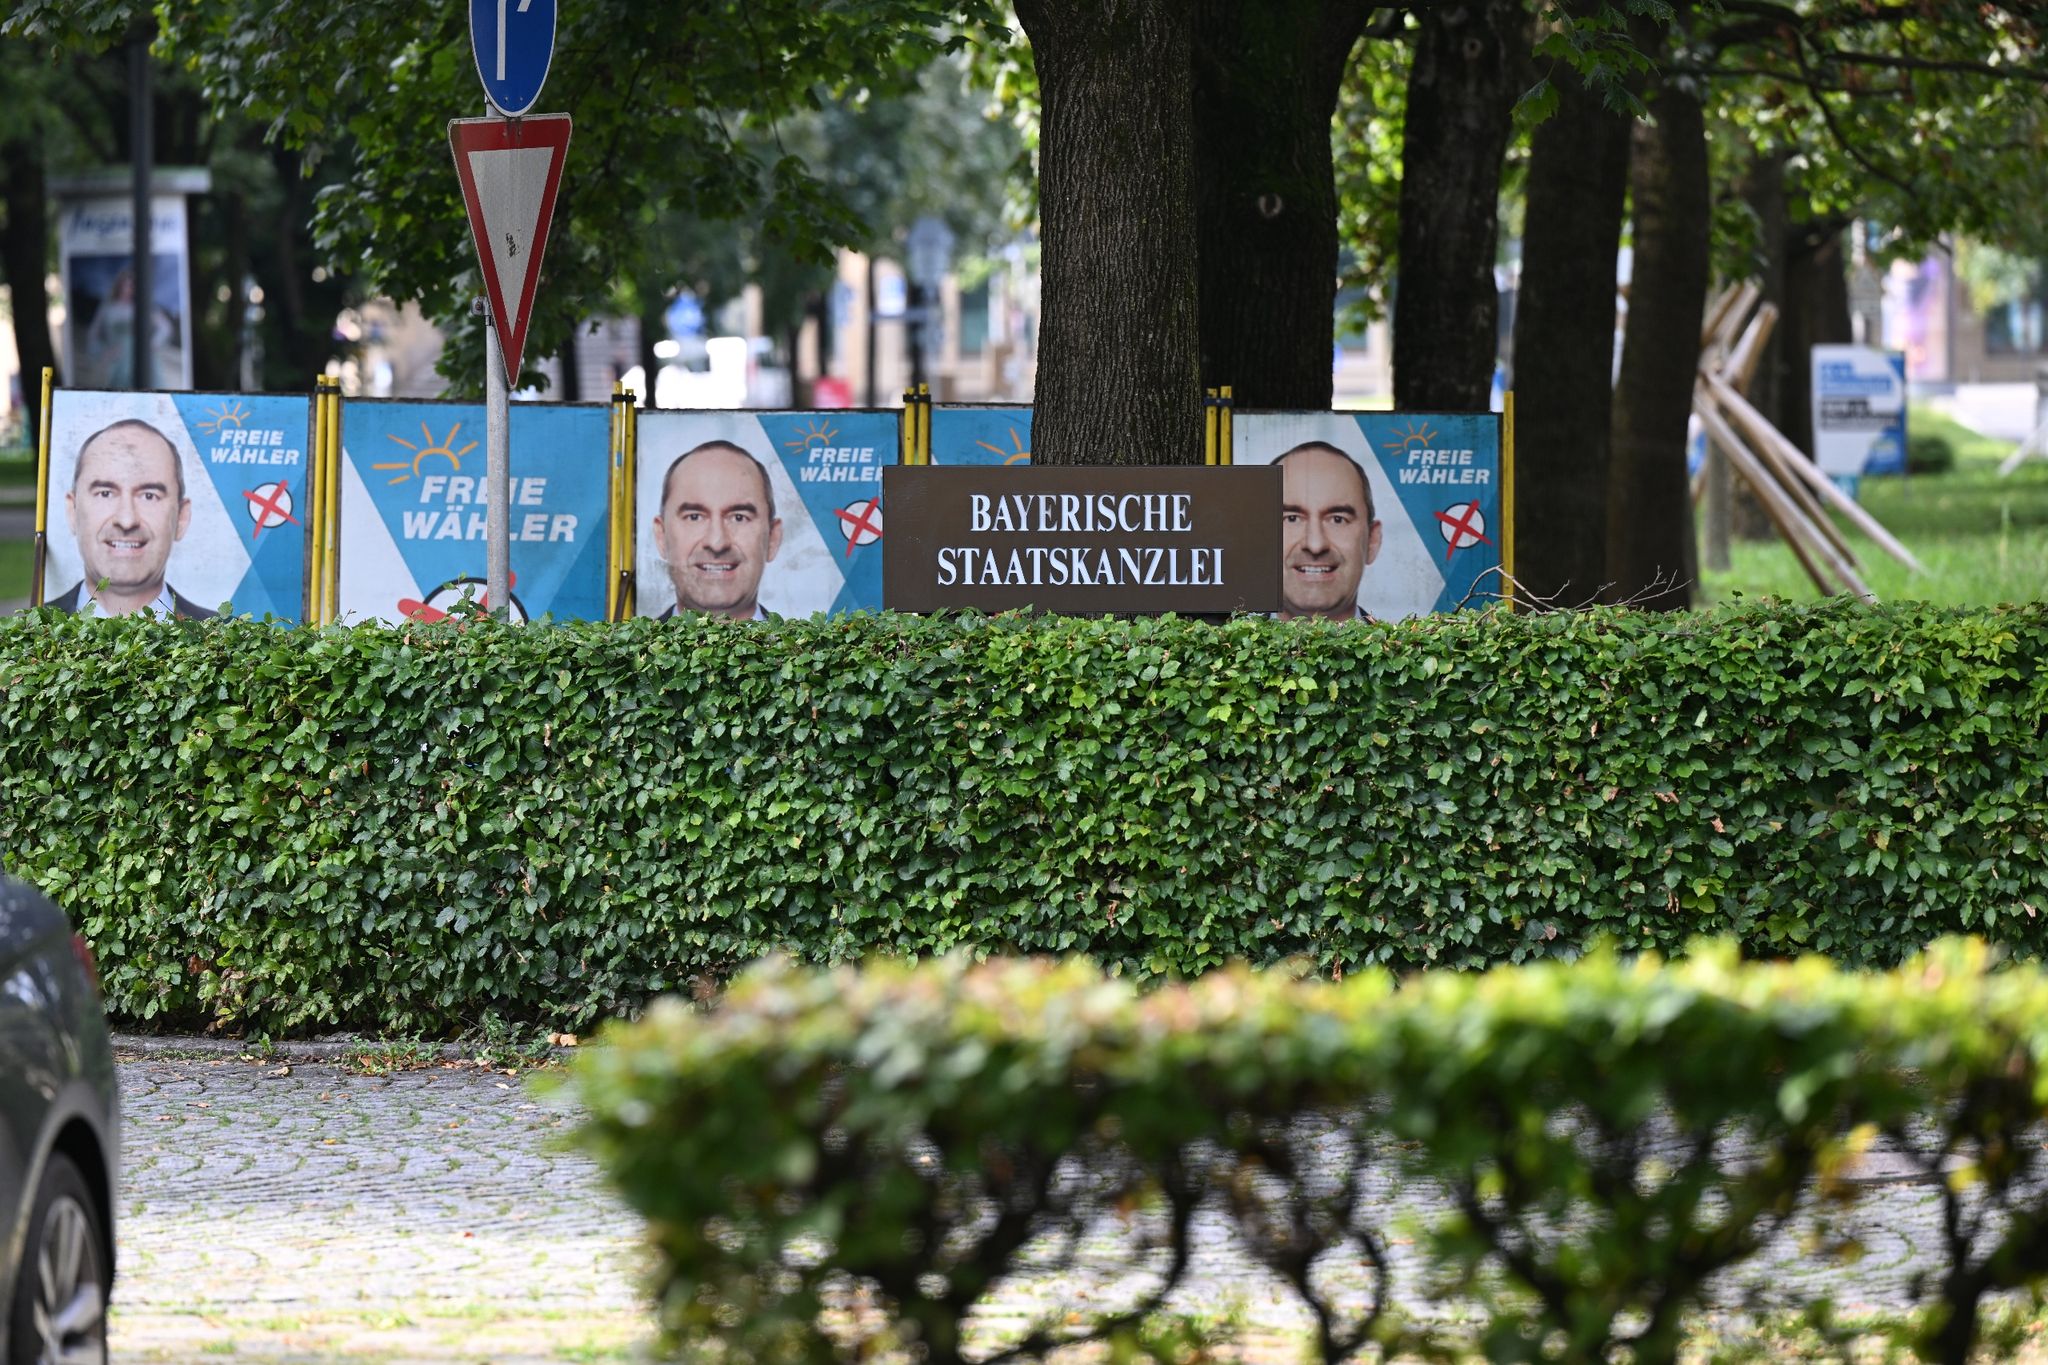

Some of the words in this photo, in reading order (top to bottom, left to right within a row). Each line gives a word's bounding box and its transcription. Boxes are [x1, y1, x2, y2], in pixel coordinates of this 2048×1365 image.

[220, 429, 284, 446] FREIE
[211, 445, 299, 465] WÄHLER
[808, 447, 874, 463] FREIE
[1407, 449, 1473, 465] FREIE
[1399, 465, 1490, 484] WÄHLER
[970, 494, 1192, 532] BAYERISCHE
[403, 505, 578, 542] WÄHER
[937, 547, 1225, 585] STAATSKANZLEI
